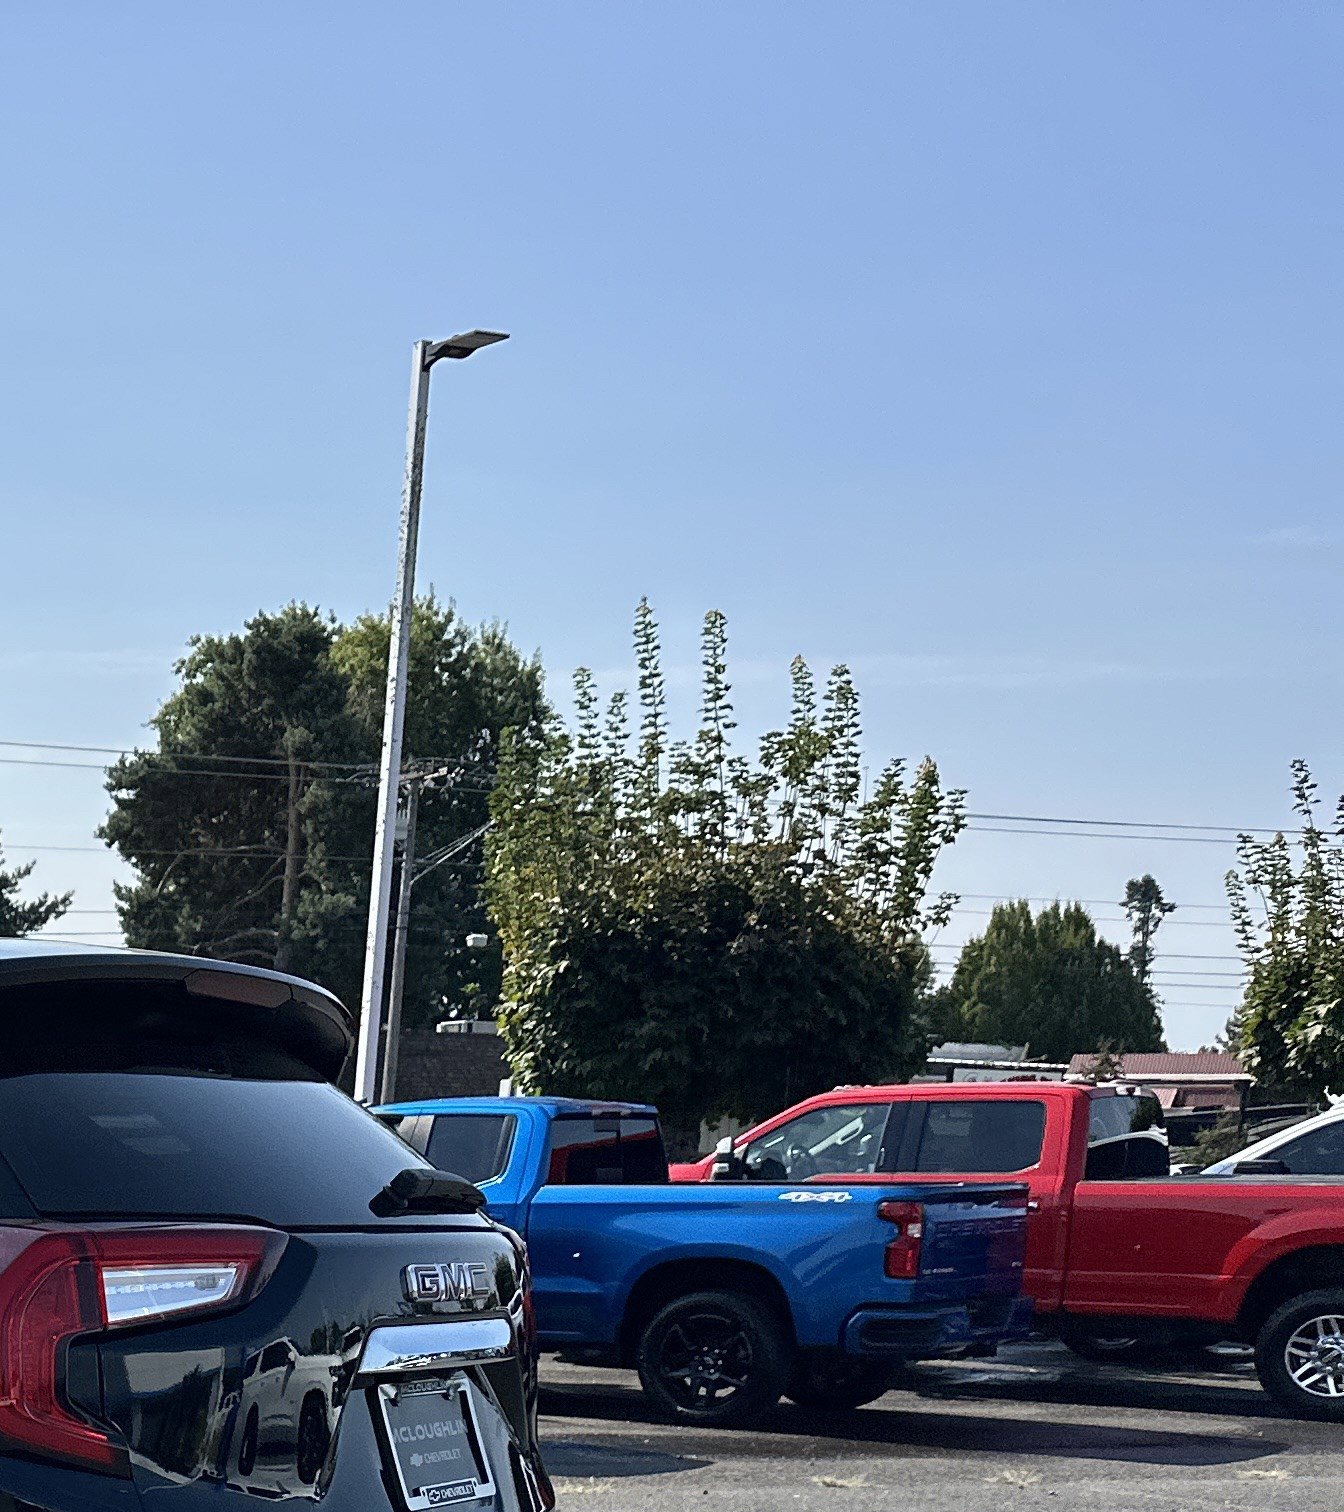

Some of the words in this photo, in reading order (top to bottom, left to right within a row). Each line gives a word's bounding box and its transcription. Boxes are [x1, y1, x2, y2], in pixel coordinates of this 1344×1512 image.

[406, 1262, 490, 1301] GMC
[423, 1448, 462, 1464] CHEVROLET
[441, 1484, 474, 1499] CHEVROLET
